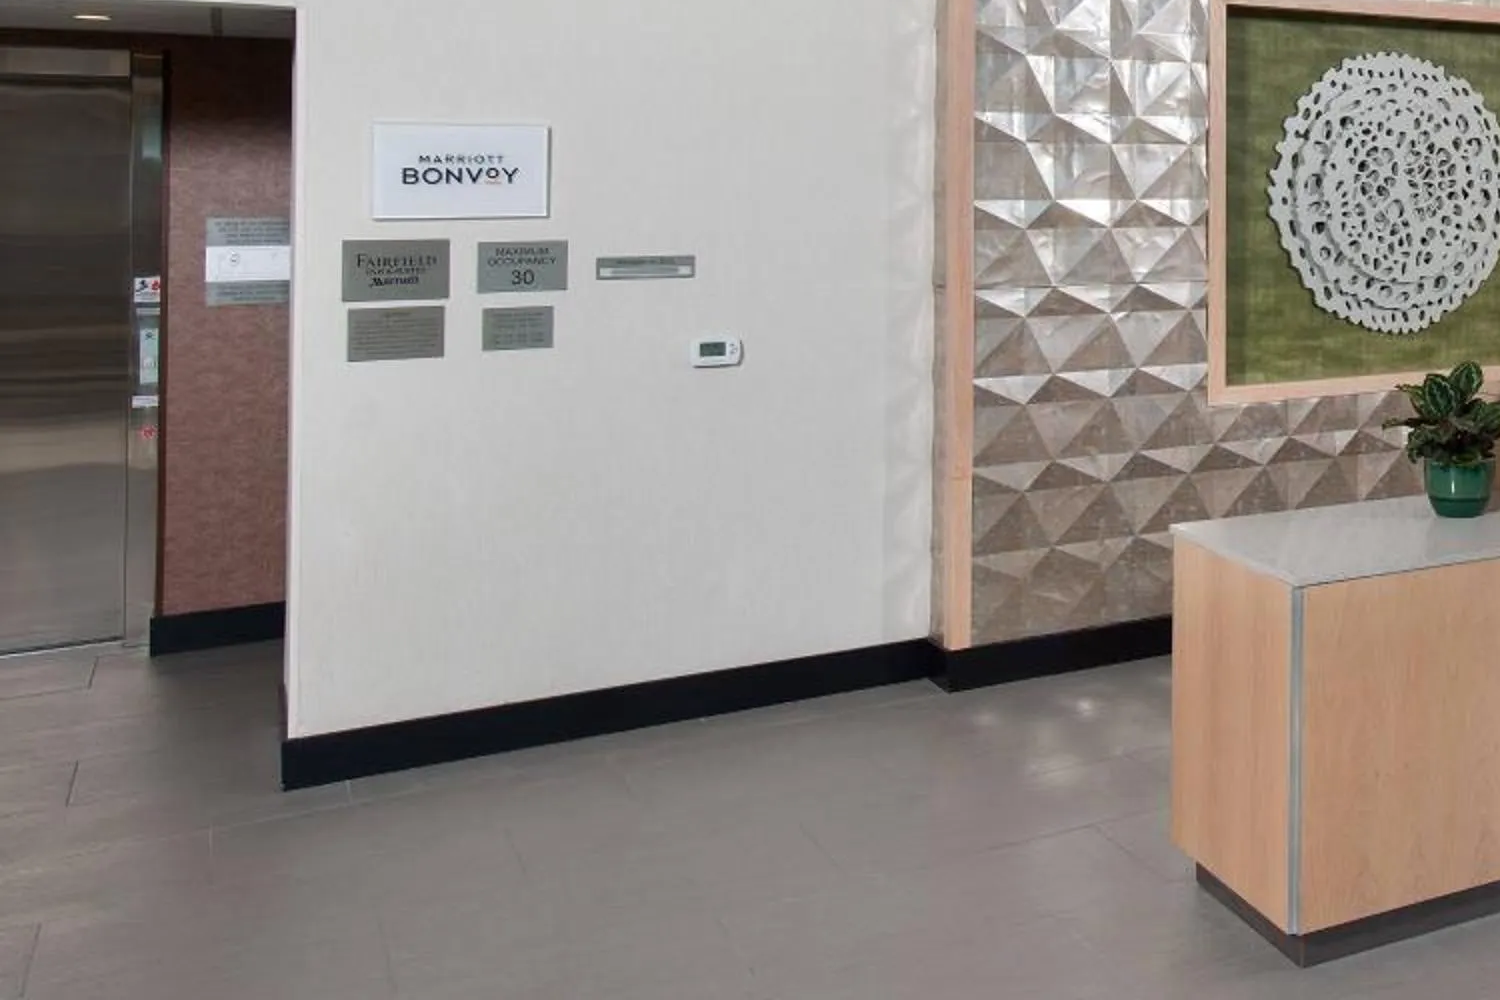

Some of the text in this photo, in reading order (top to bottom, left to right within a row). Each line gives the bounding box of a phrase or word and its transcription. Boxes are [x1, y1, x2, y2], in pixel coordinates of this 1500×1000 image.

[418, 155, 504, 165] MARRIOTT
[402, 167, 519, 185] BONVOY
[511, 269, 535, 285] 30
